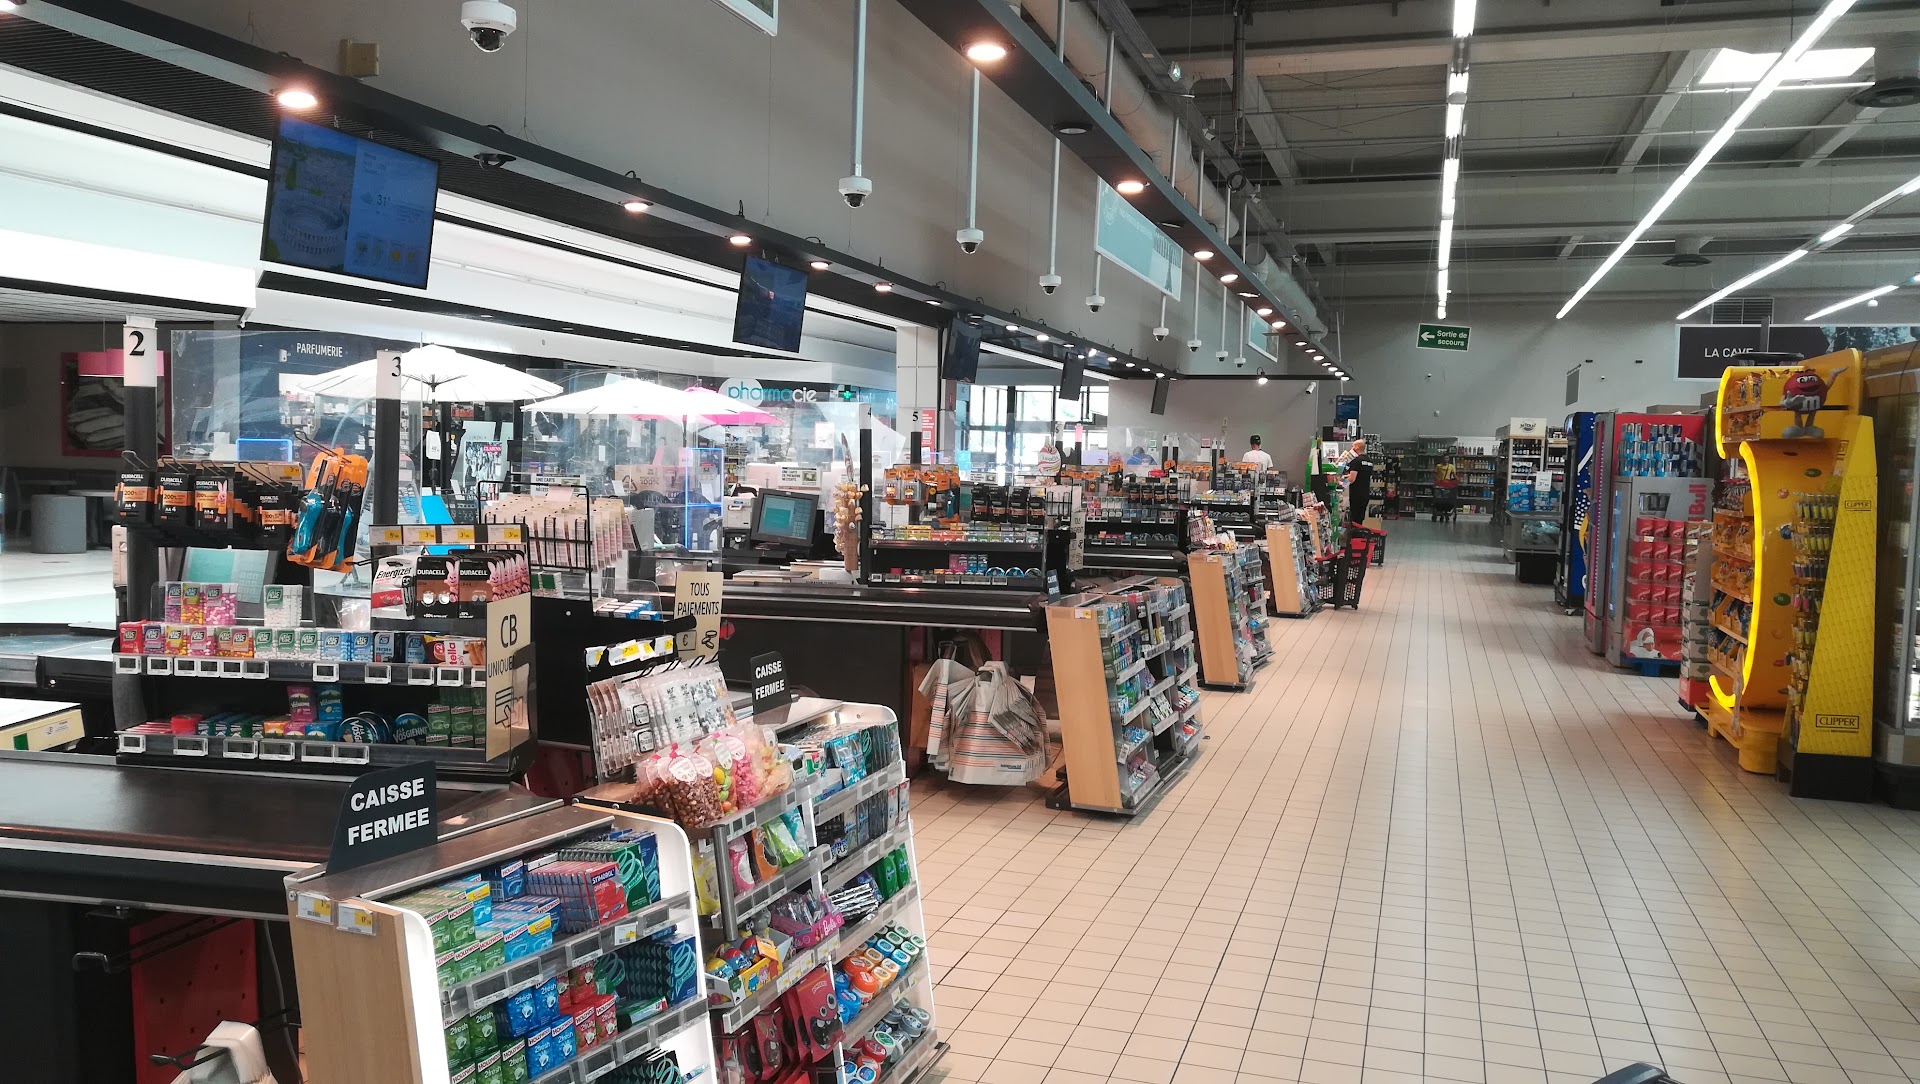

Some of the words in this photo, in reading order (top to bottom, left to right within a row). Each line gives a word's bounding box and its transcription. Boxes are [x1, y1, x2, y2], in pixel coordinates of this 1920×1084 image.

[1436, 330, 1457, 338] Sortie
[128, 330, 146, 357] 2
[296, 342, 344, 358] PARFUMERIE
[1704, 347, 1720, 358] LA
[391, 356, 402, 377] 3
[728, 381, 818, 403] pharmacie
[912, 411, 919, 422] 5
[376, 566, 412, 580] Energizer
[690, 582, 710, 596] TOUS
[677, 601, 720, 616] PAIEMENTS
[501, 614, 518, 648] CB
[447, 642, 457, 666] tella
[487, 655, 514, 679] UNIQUE
[755, 660, 783, 679] CAISSE
[755, 679, 785, 700] FERMEE
[1819, 716, 1856, 727] CLIPPER
[350, 777, 425, 812] CAISSE
[348, 807, 430, 846] FERMEE
[502, 861, 523, 875] HOLLYWOOD
[427, 910, 447, 924] OLLYWOOD
[449, 903, 473, 919] HOLLYWOOD
[504, 924, 528, 940] HOLLYWOOD
[823, 917, 837, 936] Barbie
[480, 933, 503, 949] HOLLYWOOD
[455, 942, 480, 959] HOLLYWOOD
[436, 952, 455, 967] LLYWOOD
[541, 984, 557, 995] 2fresh
[515, 993, 533, 1005] 2fresh
[475, 1011, 494, 1024] 2fresh
[449, 1023, 469, 1036] 2fresh
[529, 1027, 551, 1045] HOLLYWOOD
[557, 1031, 574, 1044] 2fresh
[503, 1041, 525, 1059] HOLLYWOOD
[534, 1042, 551, 1053] 2fresh
[479, 1052, 501, 1071] HOLLYWOOD
[508, 1054, 526, 1067] 2fresh
[453, 1065, 476, 1083] HOLLYWOOD
[484, 1065, 502, 1079] 2fresh
